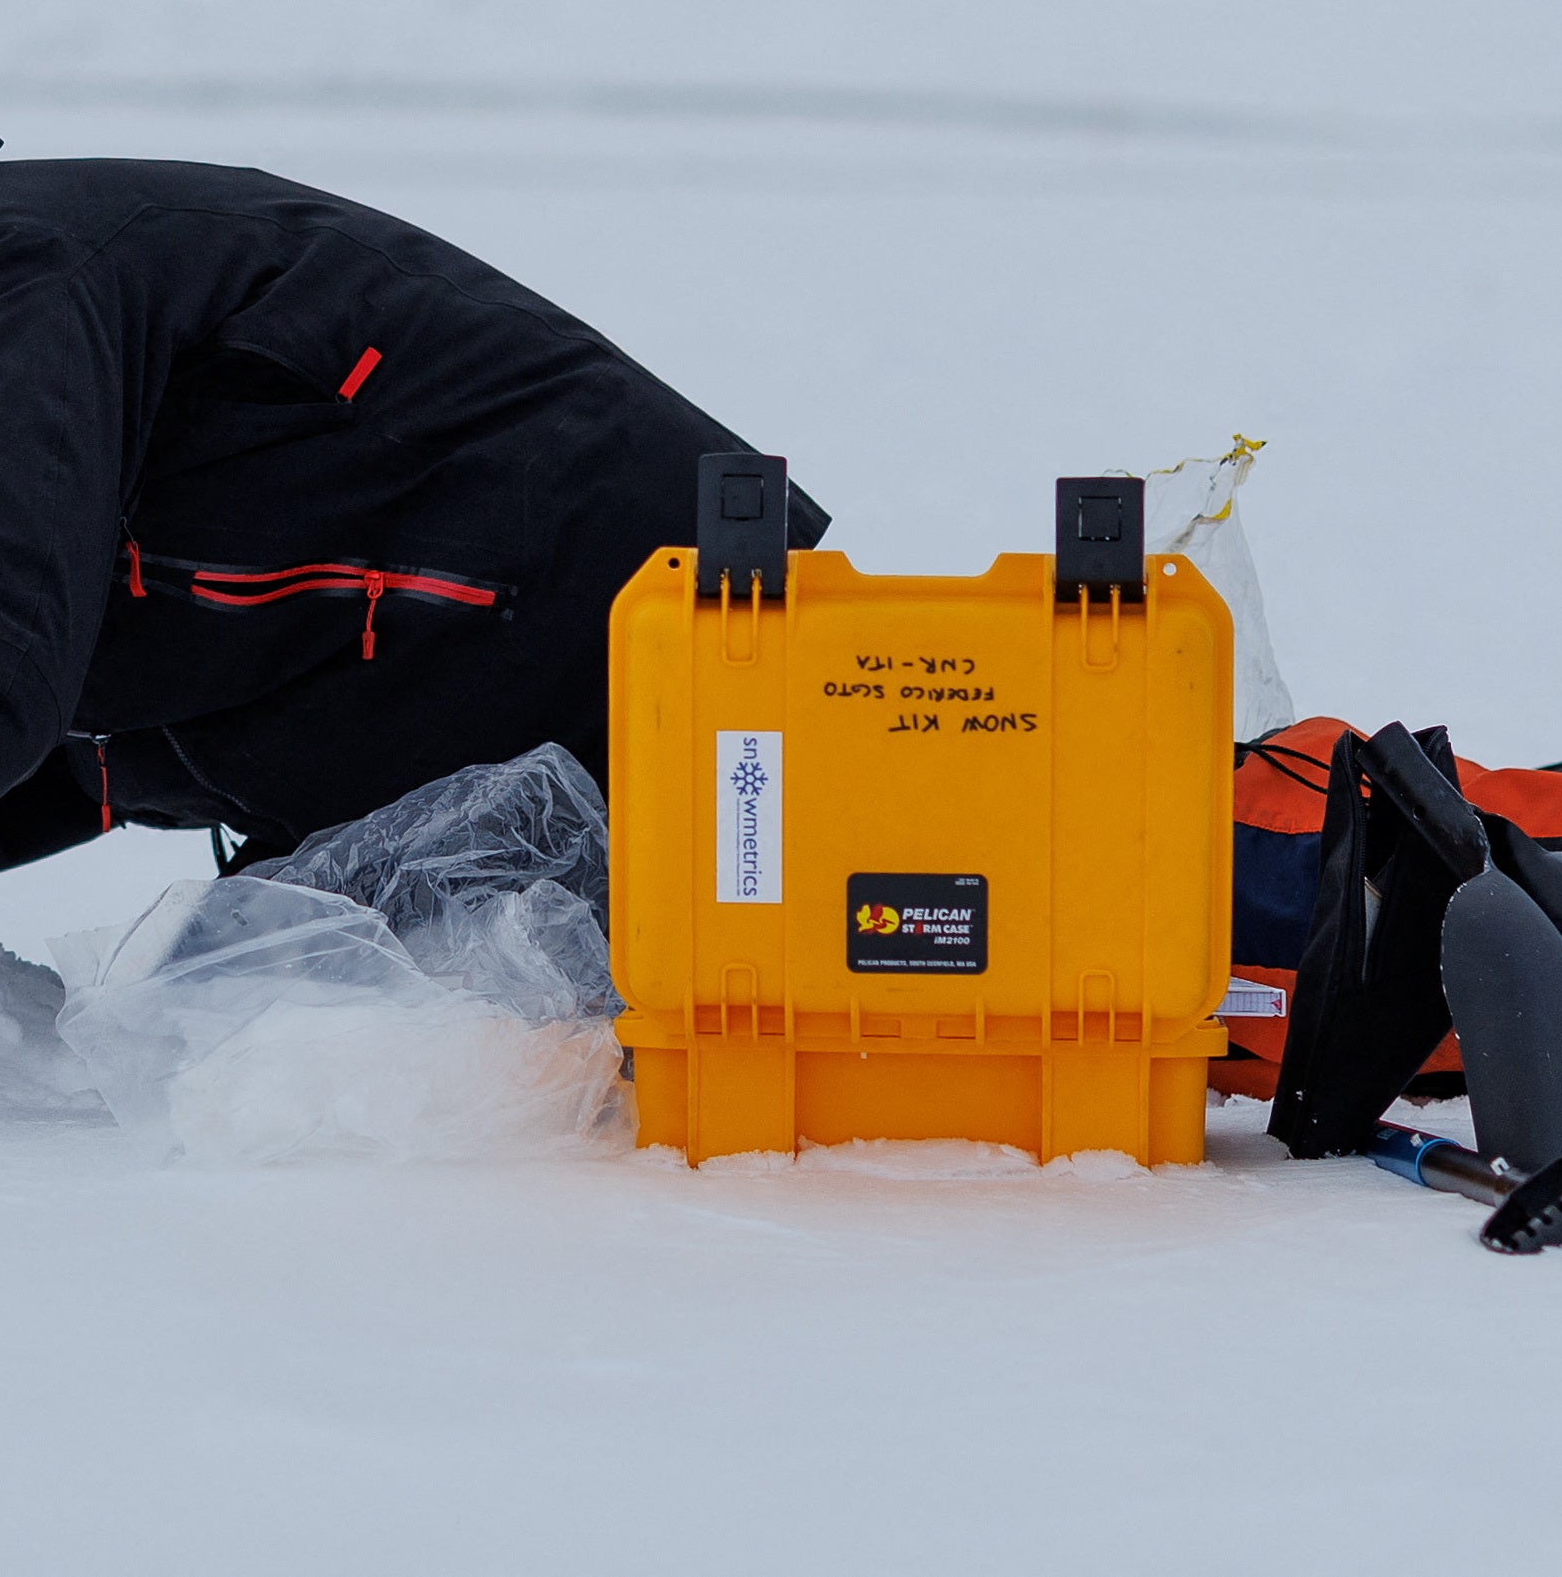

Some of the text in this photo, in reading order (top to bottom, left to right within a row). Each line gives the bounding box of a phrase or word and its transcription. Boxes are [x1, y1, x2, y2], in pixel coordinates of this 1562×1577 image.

[900, 686, 995, 703] FEDERICO
[888, 713, 1037, 733] SNOW KIT
[902, 907, 972, 921] PELICAN
[943, 923, 970, 934] CASE
